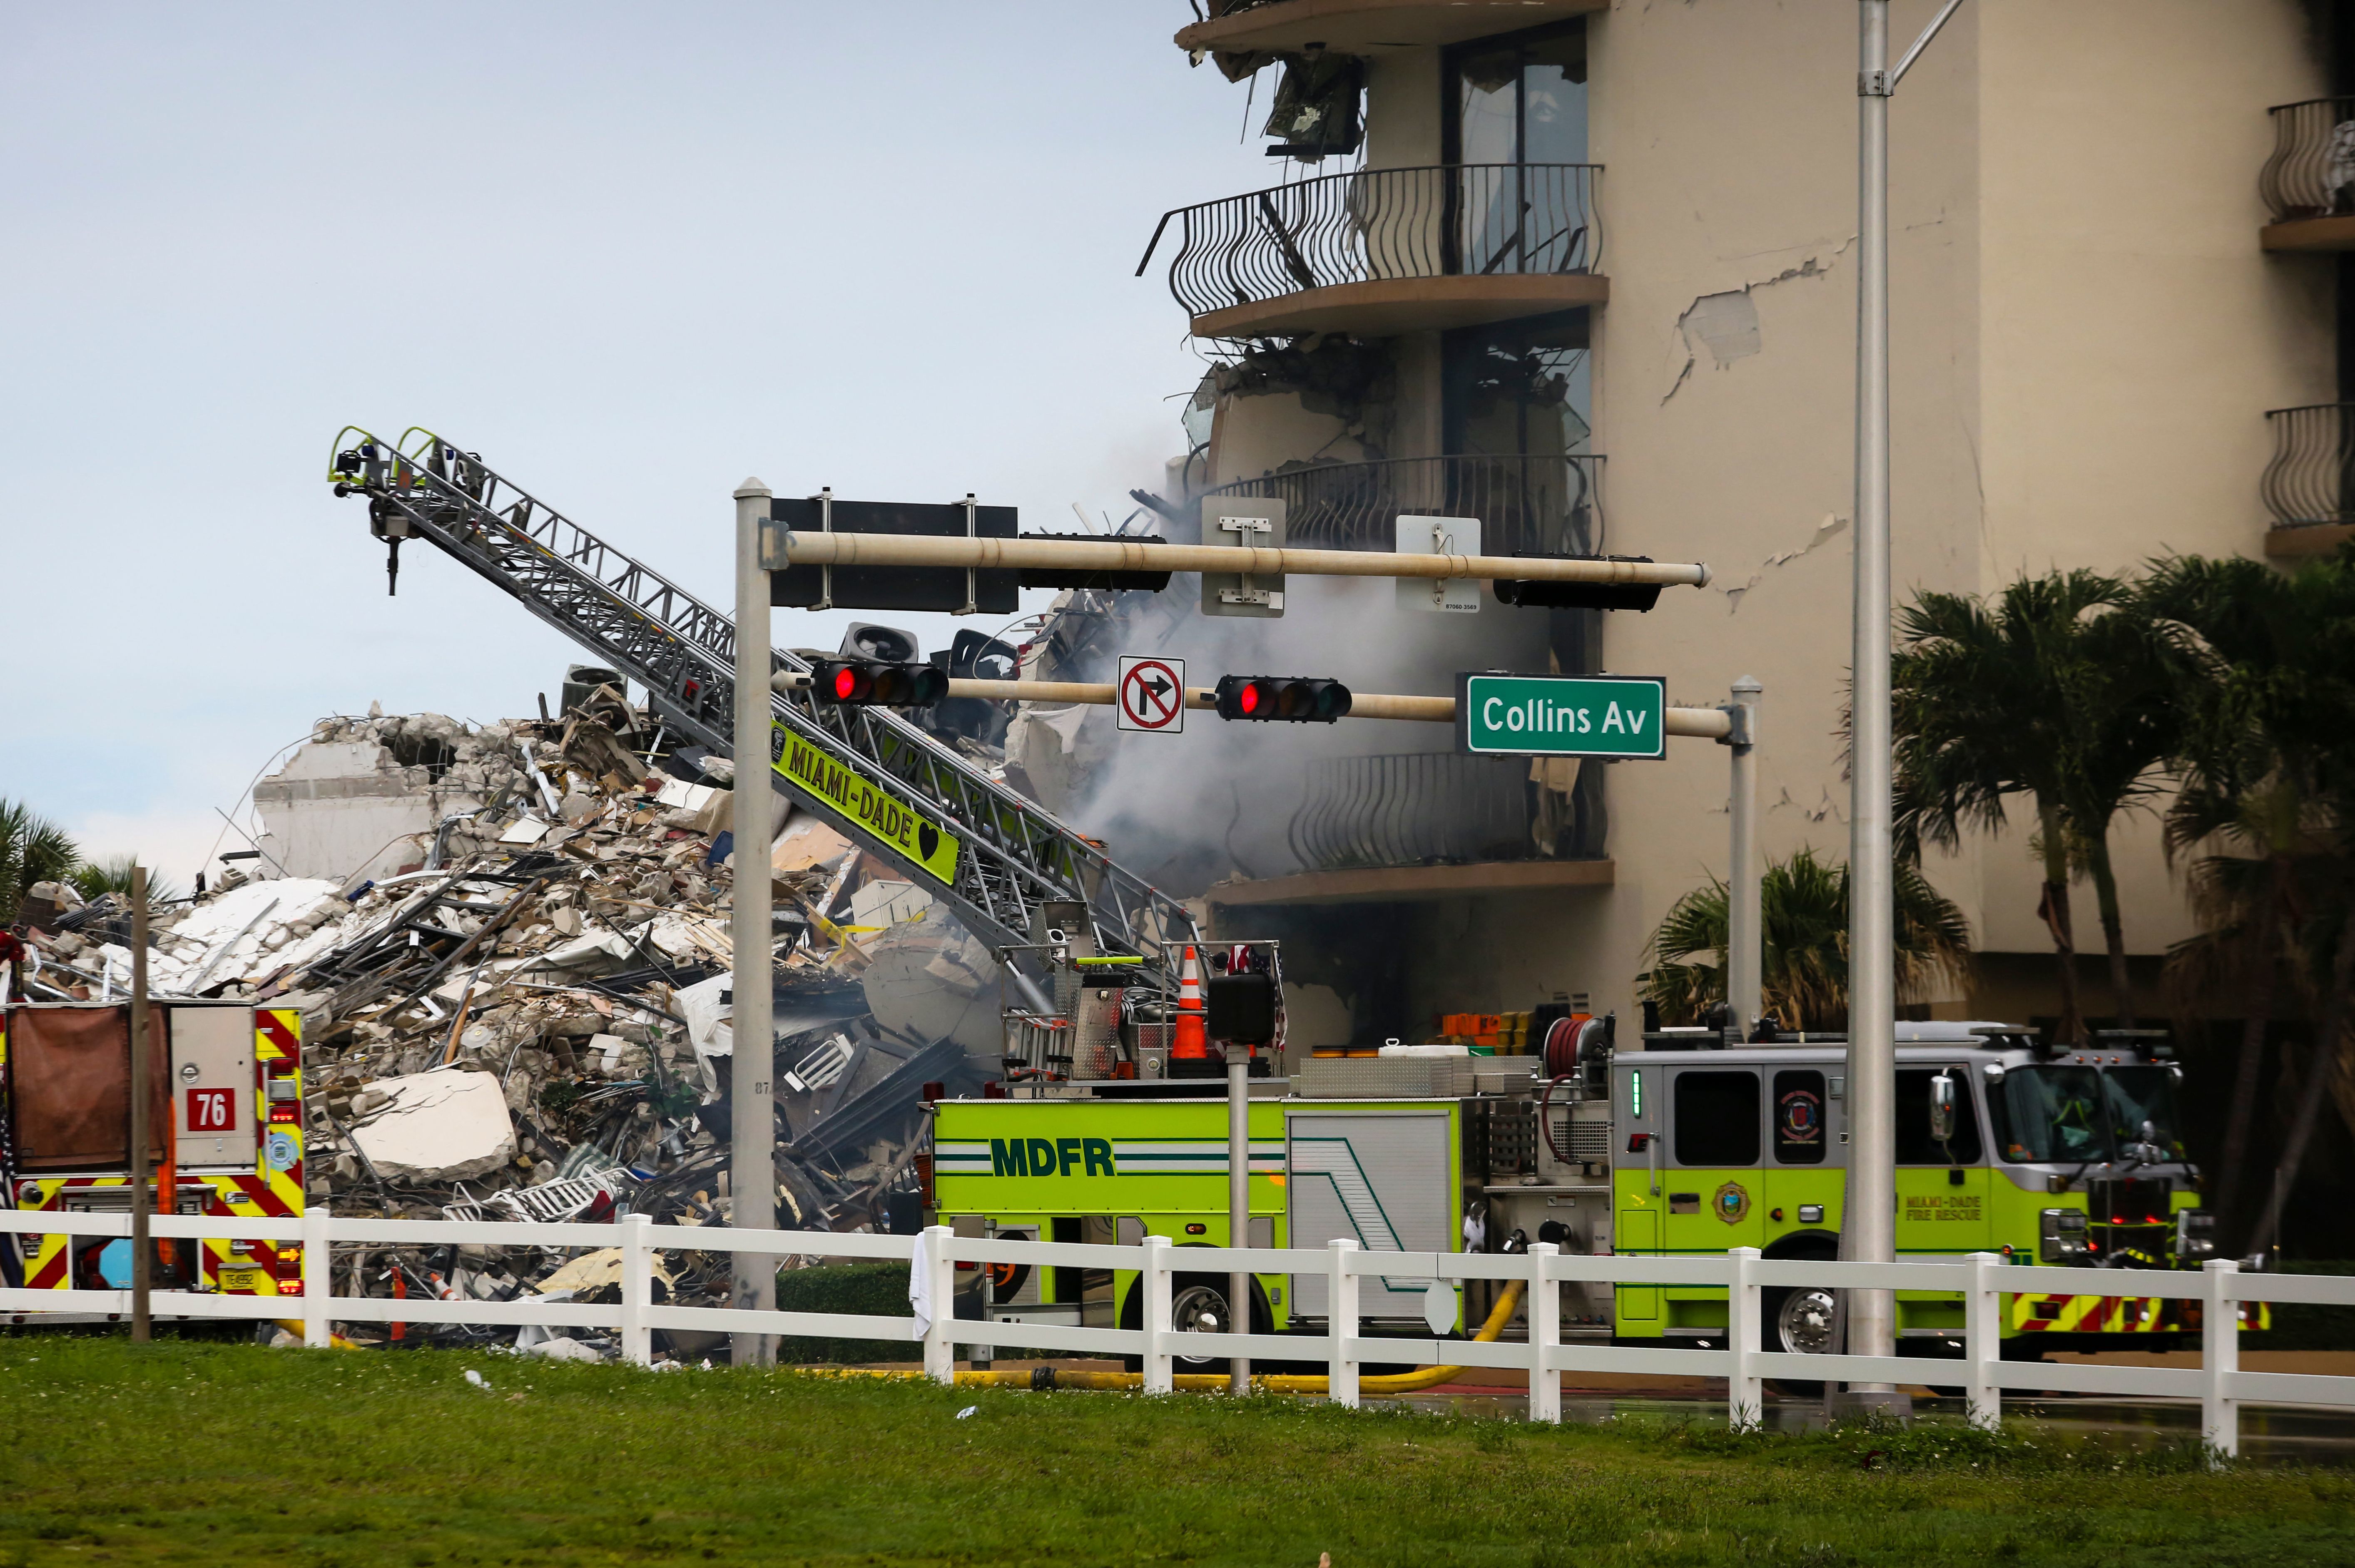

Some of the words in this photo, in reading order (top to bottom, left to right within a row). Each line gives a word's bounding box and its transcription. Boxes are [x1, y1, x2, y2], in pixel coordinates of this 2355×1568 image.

[1483, 697, 1591, 733] Collins
[1601, 701, 1647, 734] Av
[789, 741, 914, 848] MIAMI-DADE
[197, 1093, 227, 1126] 76
[990, 1138, 1115, 1177] MDFR
[1906, 1210, 1932, 1220] FIRE
[1935, 1210, 1981, 1220] RESCUE
